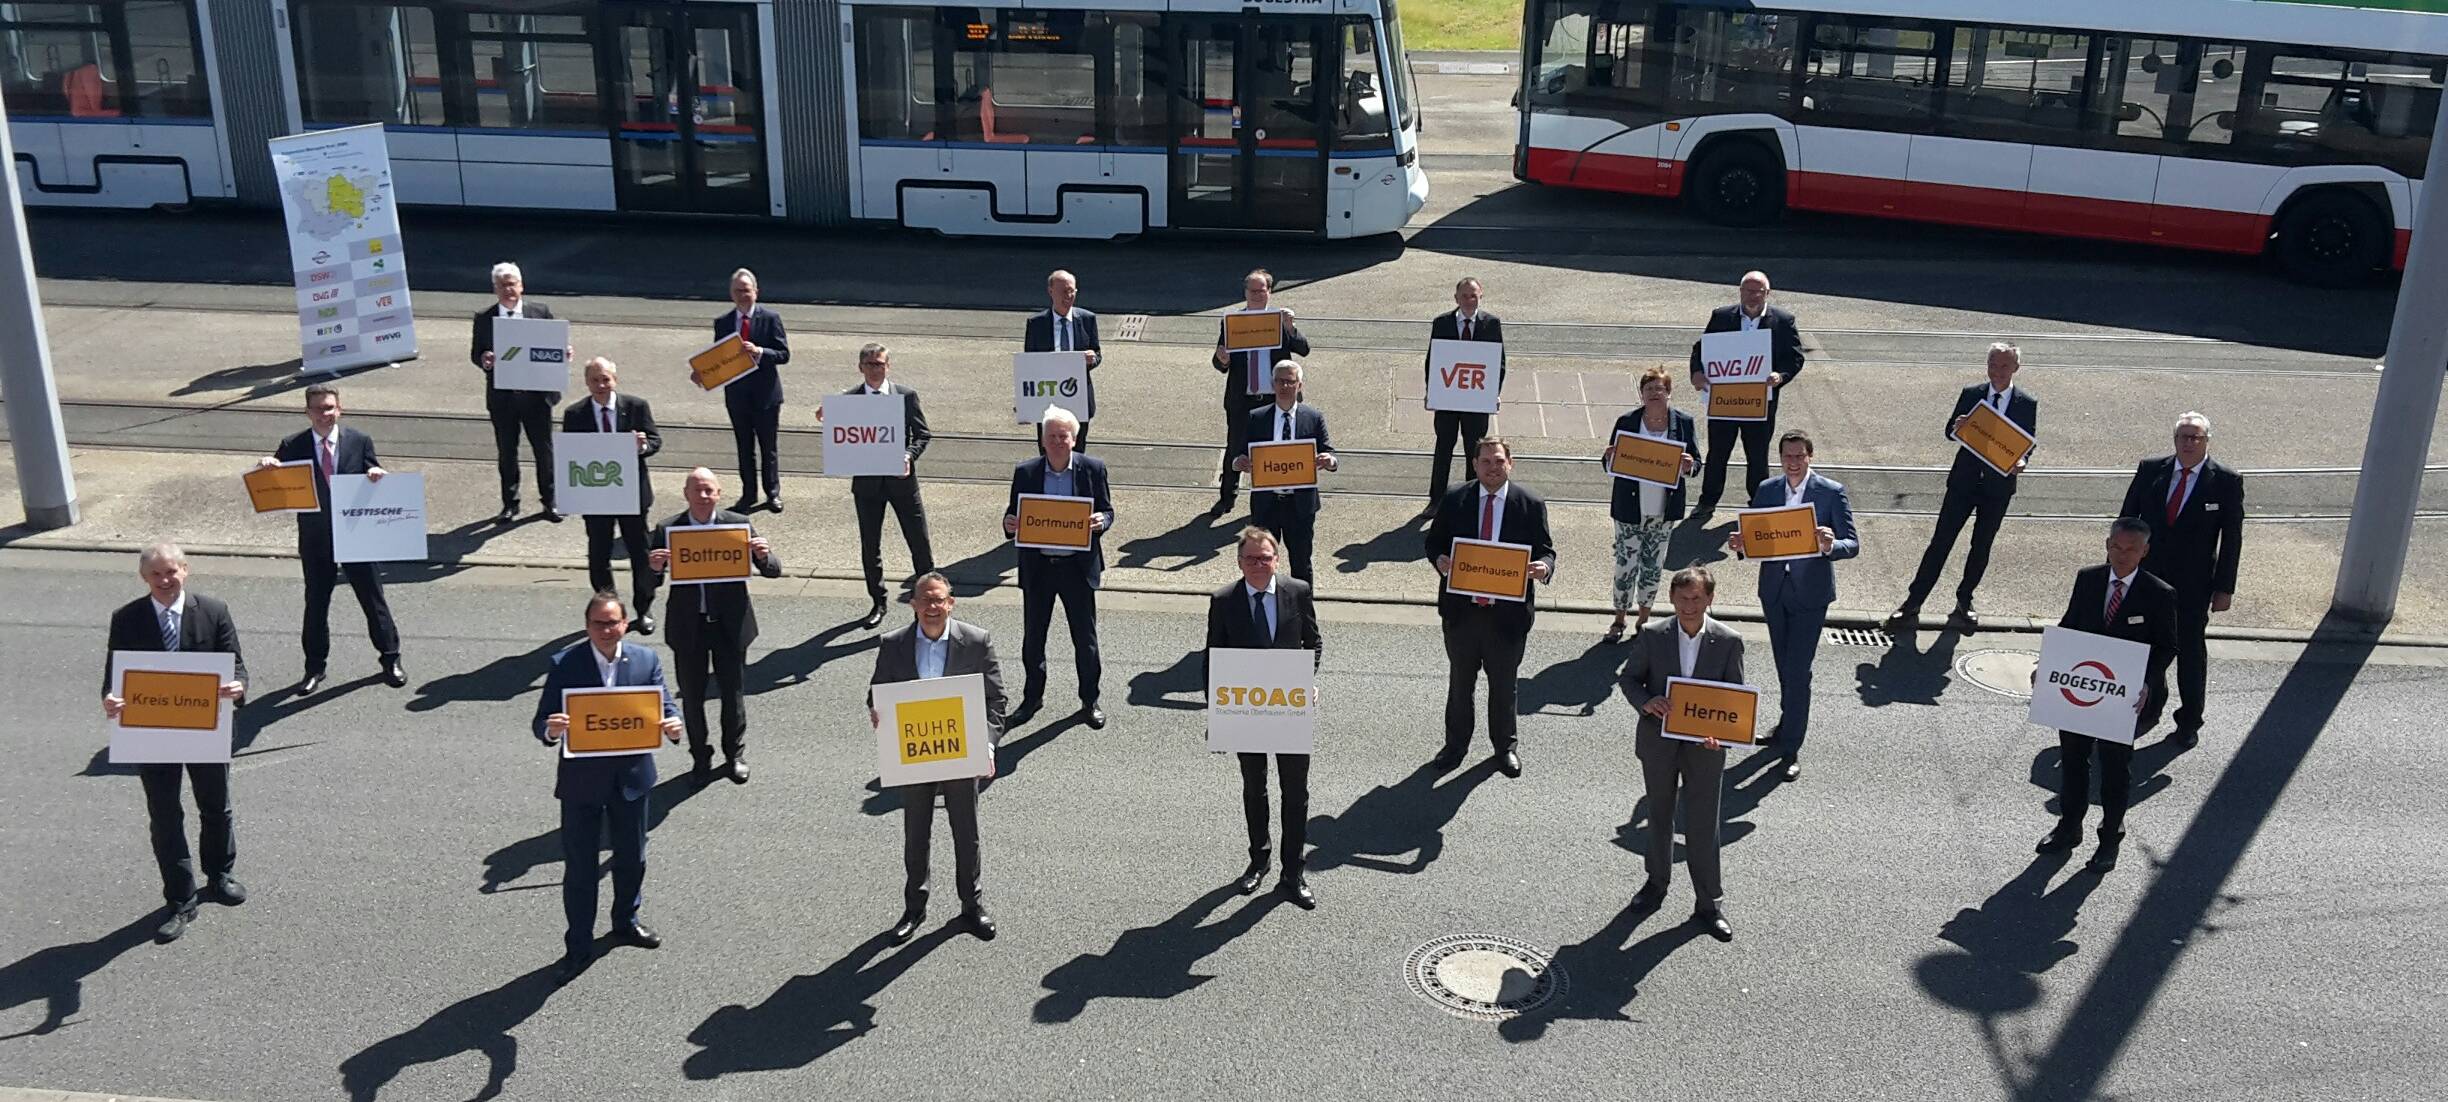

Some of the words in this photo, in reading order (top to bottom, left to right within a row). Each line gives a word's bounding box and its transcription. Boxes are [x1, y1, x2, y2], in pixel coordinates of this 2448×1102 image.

[376, 295, 392, 307] VER
[530, 350, 563, 361] NIAG
[1441, 363, 1487, 390] VER
[1022, 380, 1058, 397] HST
[1715, 396, 1762, 407] Duisburg
[1263, 460, 1304, 474] Hagen
[342, 507, 403, 517] VESTISCHE
[1026, 515, 1084, 530] Dortmund
[1754, 528, 1802, 541] Bochum
[680, 548, 742, 564] Bottrop
[1458, 561, 1519, 578] Oberhausen
[2049, 670, 2126, 698] BOGESTRA
[132, 693, 169, 706] Kreis
[174, 695, 210, 708] Unna
[1216, 686, 1306, 708] STOAG
[1684, 702, 1738, 724] Herne
[585, 714, 644, 731] Essen
[904, 718, 957, 738] RUHR
[906, 737, 960, 757] BAHN
